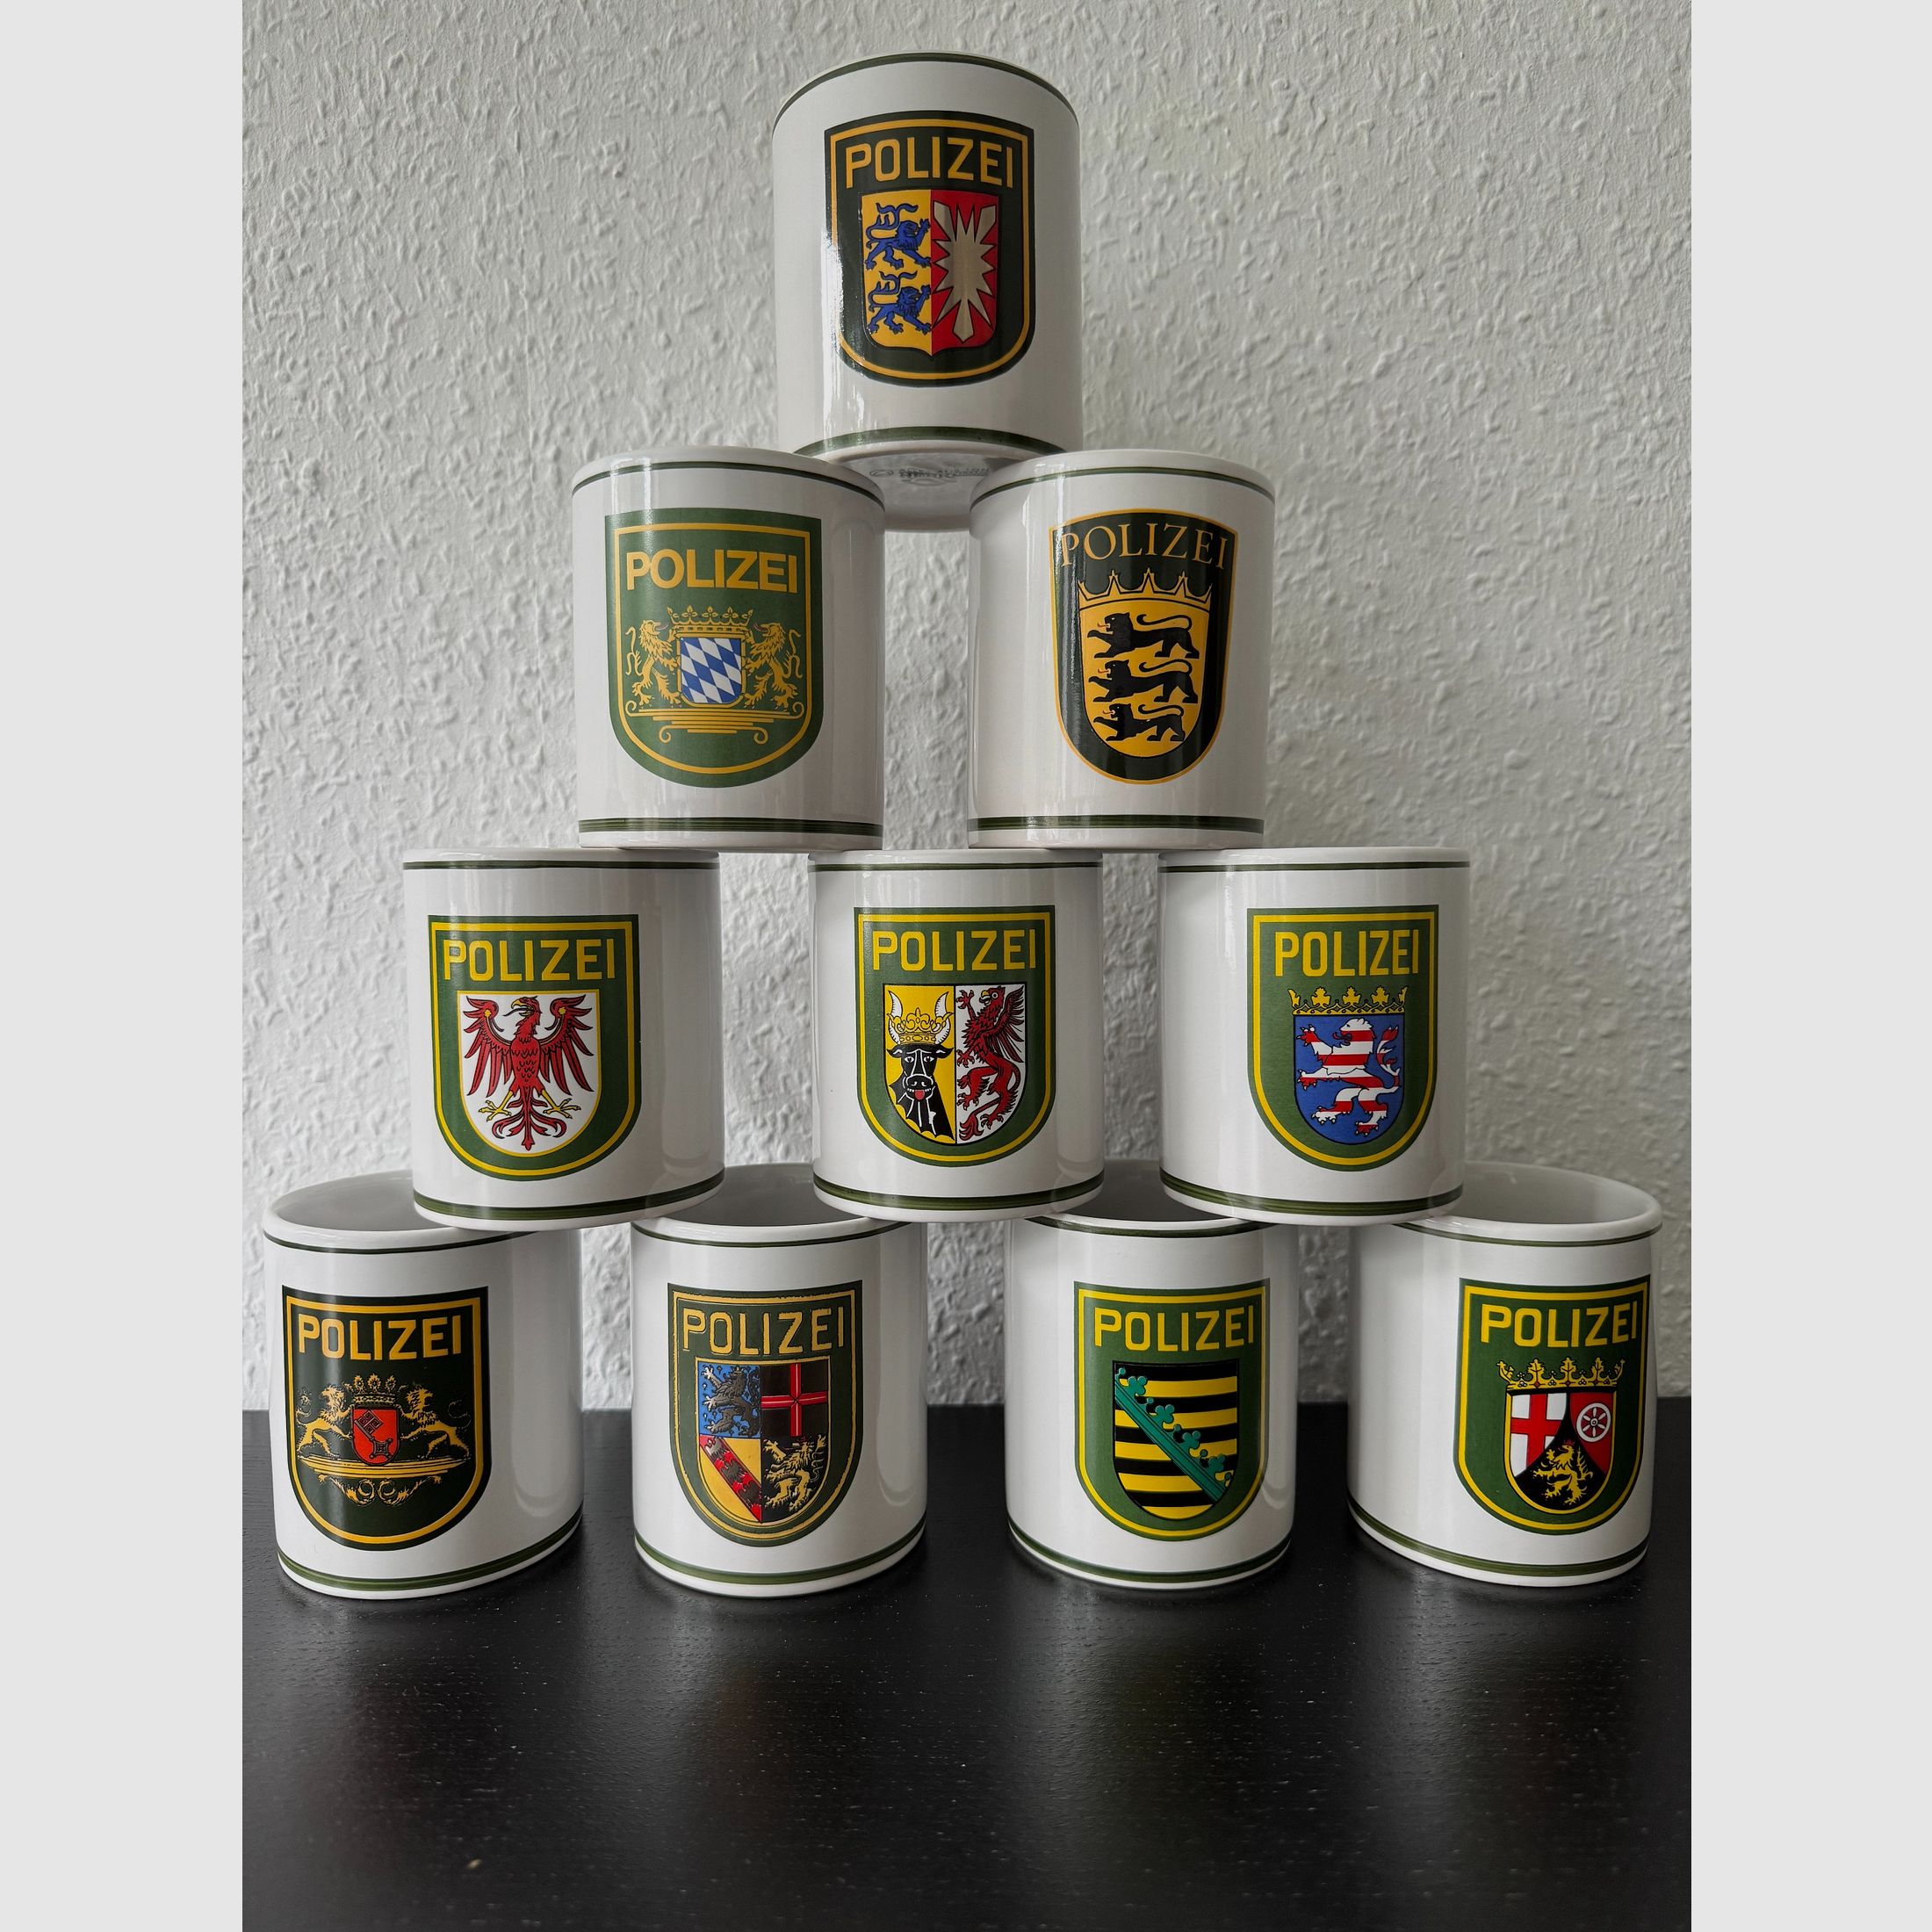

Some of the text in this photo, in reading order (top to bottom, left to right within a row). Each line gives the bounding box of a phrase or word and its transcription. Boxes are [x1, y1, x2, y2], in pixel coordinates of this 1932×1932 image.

[846, 136, 1013, 190] POLIZEI
[1060, 523, 1229, 569] POLIZEI
[625, 549, 798, 594] POLIZEI
[443, 938, 616, 982] POLIZEI
[873, 929, 1036, 971] POLIZEI
[1274, 929, 1419, 977] POLIZEI
[298, 1314, 461, 1360] POLIZEI
[682, 1307, 844, 1356] POLIZEI
[1094, 1305, 1255, 1352] POLIZEI
[1481, 1301, 1638, 1348] POLIZEI
